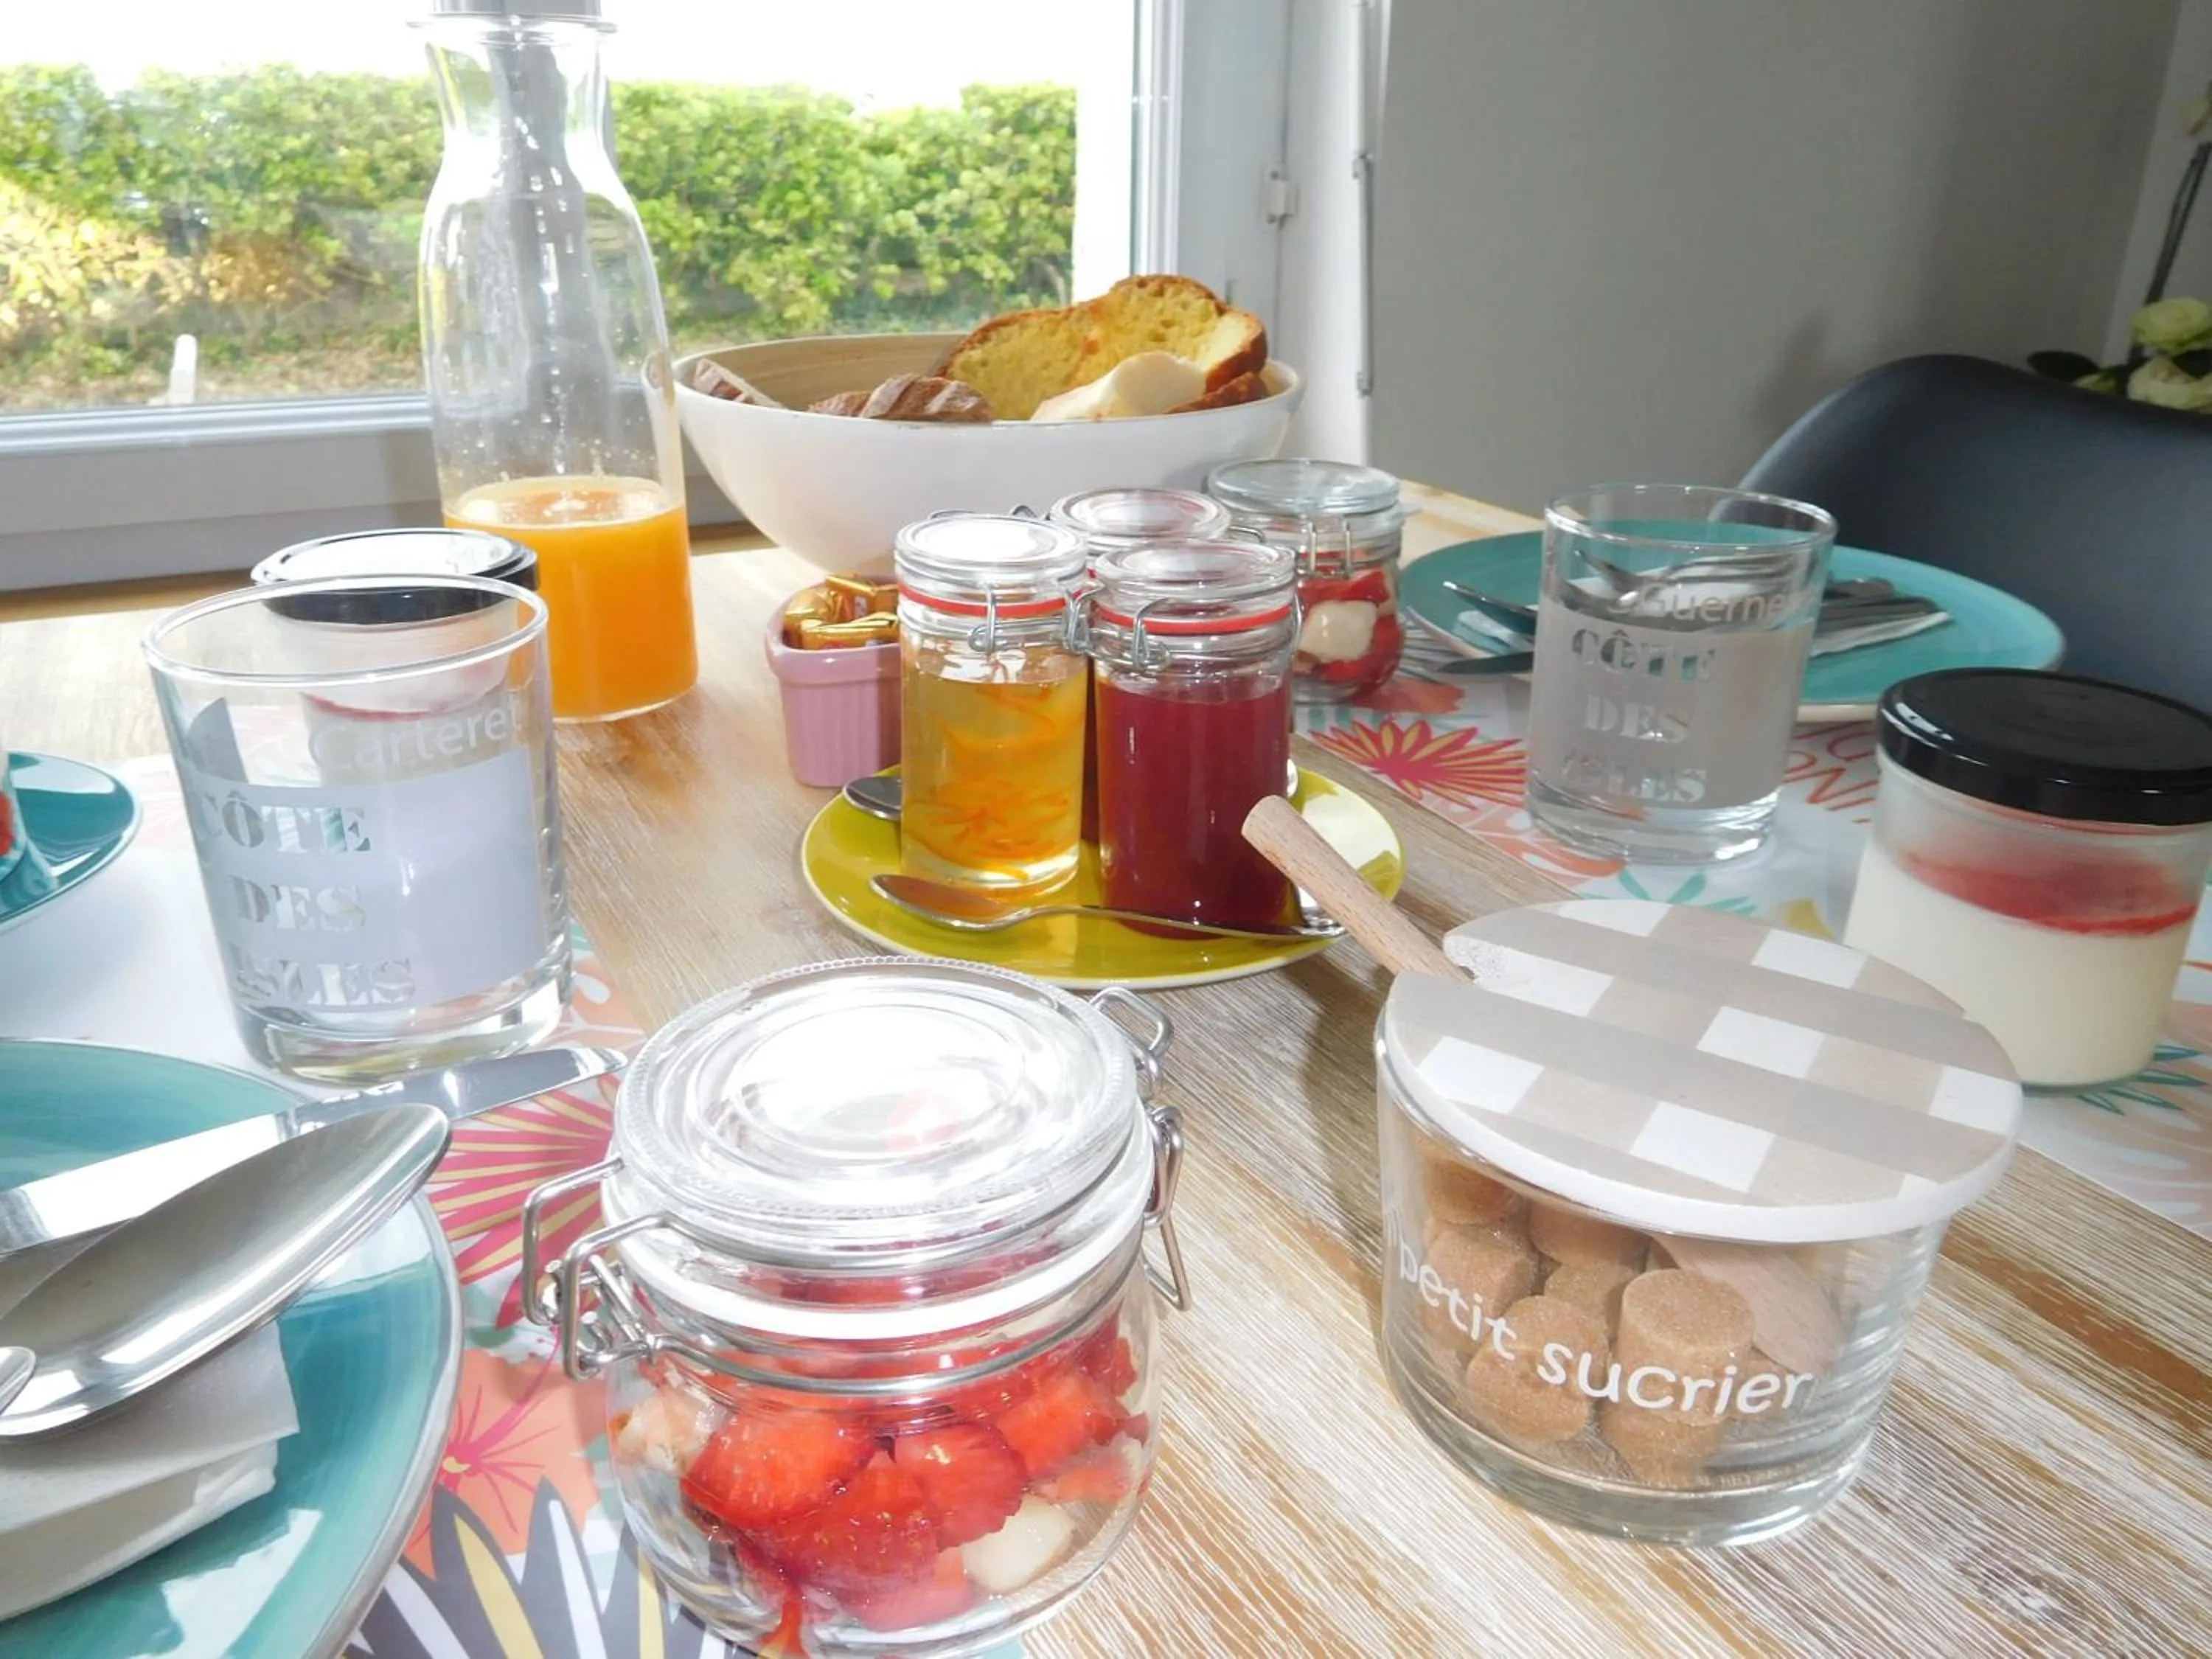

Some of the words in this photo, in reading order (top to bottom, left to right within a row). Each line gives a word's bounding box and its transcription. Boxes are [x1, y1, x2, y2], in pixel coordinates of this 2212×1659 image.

[310, 692, 523, 769] Carteret
[1582, 694, 1694, 745] DES
[193, 790, 371, 854] CÔTE
[226, 874, 366, 933] DES
[1399, 1239, 1518, 1361] petit
[1537, 1342, 1814, 1418] sucrier
